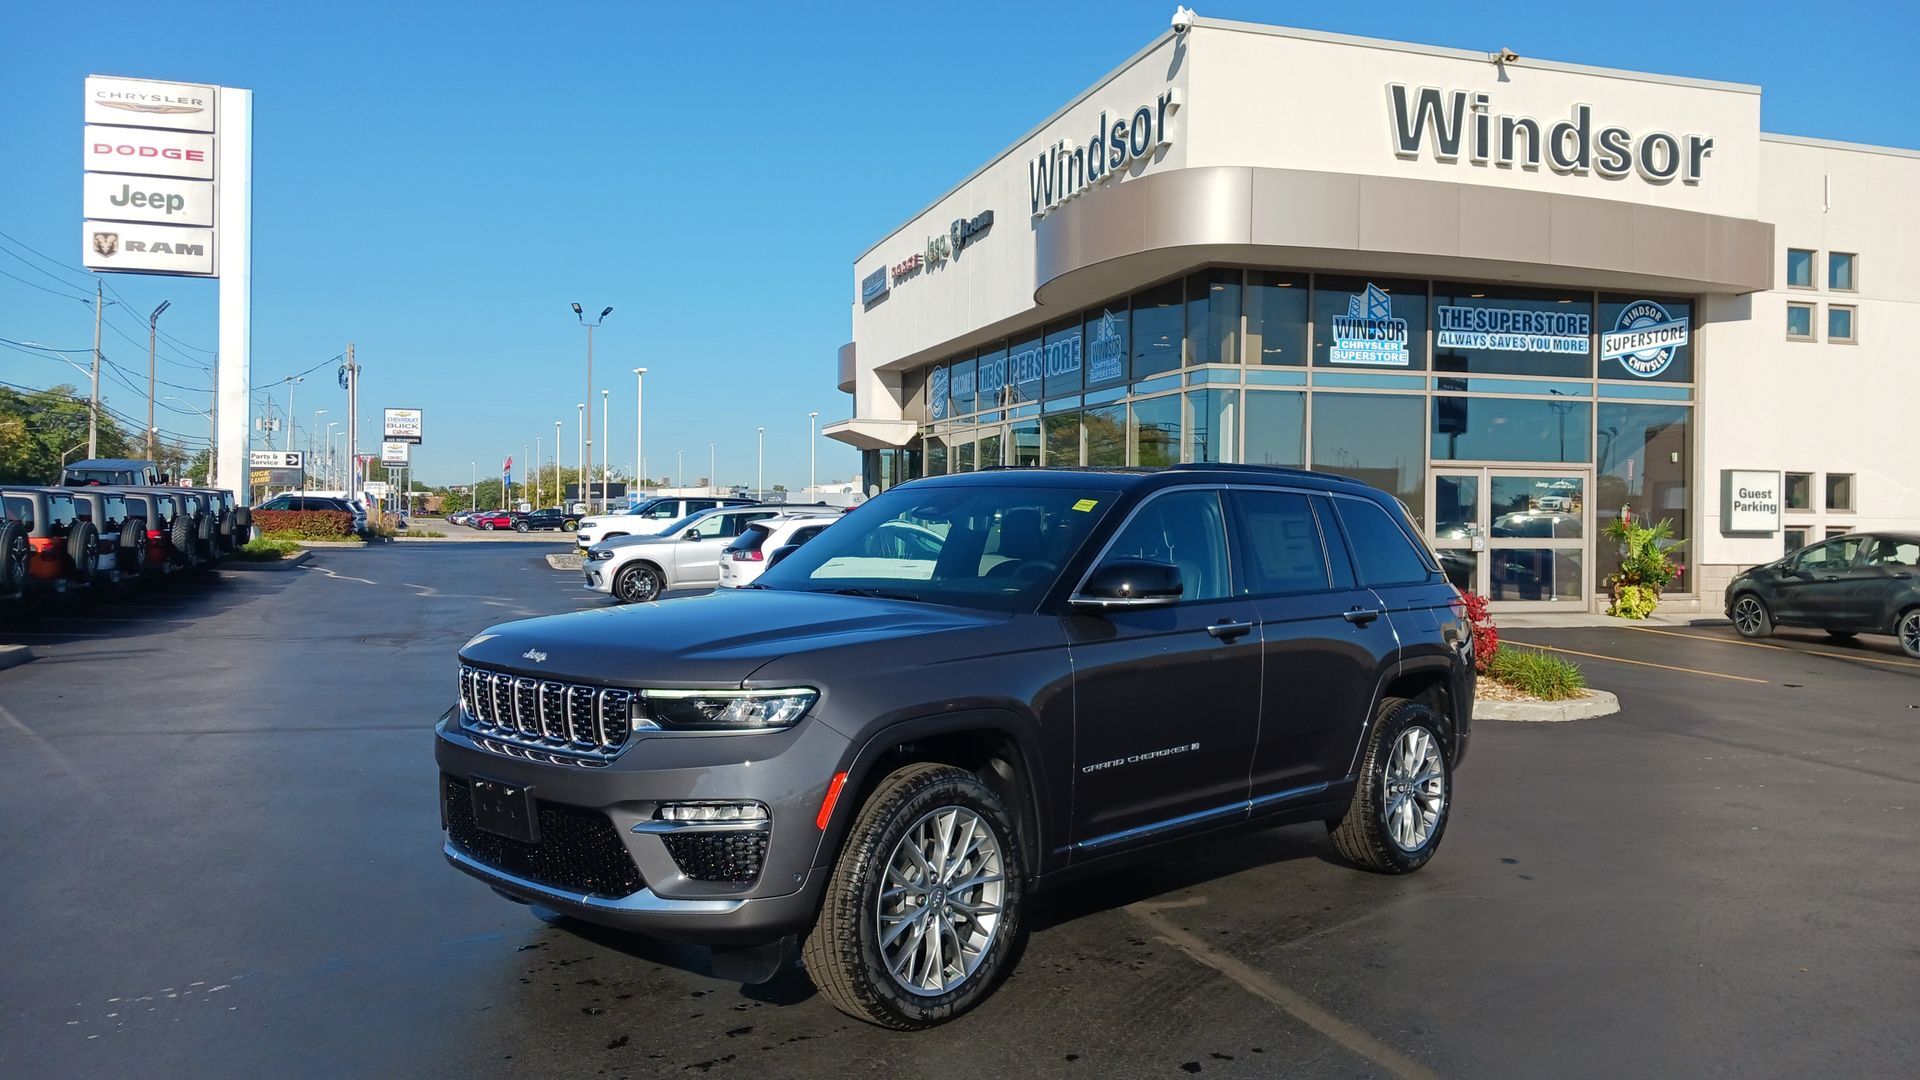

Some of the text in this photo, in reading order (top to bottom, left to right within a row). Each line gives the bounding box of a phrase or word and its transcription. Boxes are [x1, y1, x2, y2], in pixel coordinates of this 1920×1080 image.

[96, 91, 203, 105] CHRYSLER
[1386, 83, 1715, 182] Windsor
[93, 143, 204, 162] DODGE
[1028, 88, 1181, 217] Windsor
[110, 184, 185, 214] Jeep
[962, 210, 994, 236] RAM
[125, 240, 204, 256] RAM
[924, 234, 950, 262] Jeep
[1440, 308, 1589, 334] THE SUPERSTORE
[1622, 306, 1662, 326] WINDSOR
[1335, 318, 1405, 342] WINDSOR
[1606, 326, 1685, 352] SUPERSTORE
[1341, 341, 1398, 350] CHRYSLER
[1440, 332, 1588, 352] ALWAYS SAVES YOU MORE!
[979, 365, 993, 391] THE
[994, 336, 1081, 390] SUPERSTORE
[1333, 351, 1407, 362] SUPERSTORE
[1628, 350, 1669, 372] CHRYSLER
[1739, 487, 1772, 499] Guest
[1734, 501, 1777, 514] Parking
[522, 648, 547, 663] Jeep
[1083, 745, 1189, 773] GRAND CHEROKEE
